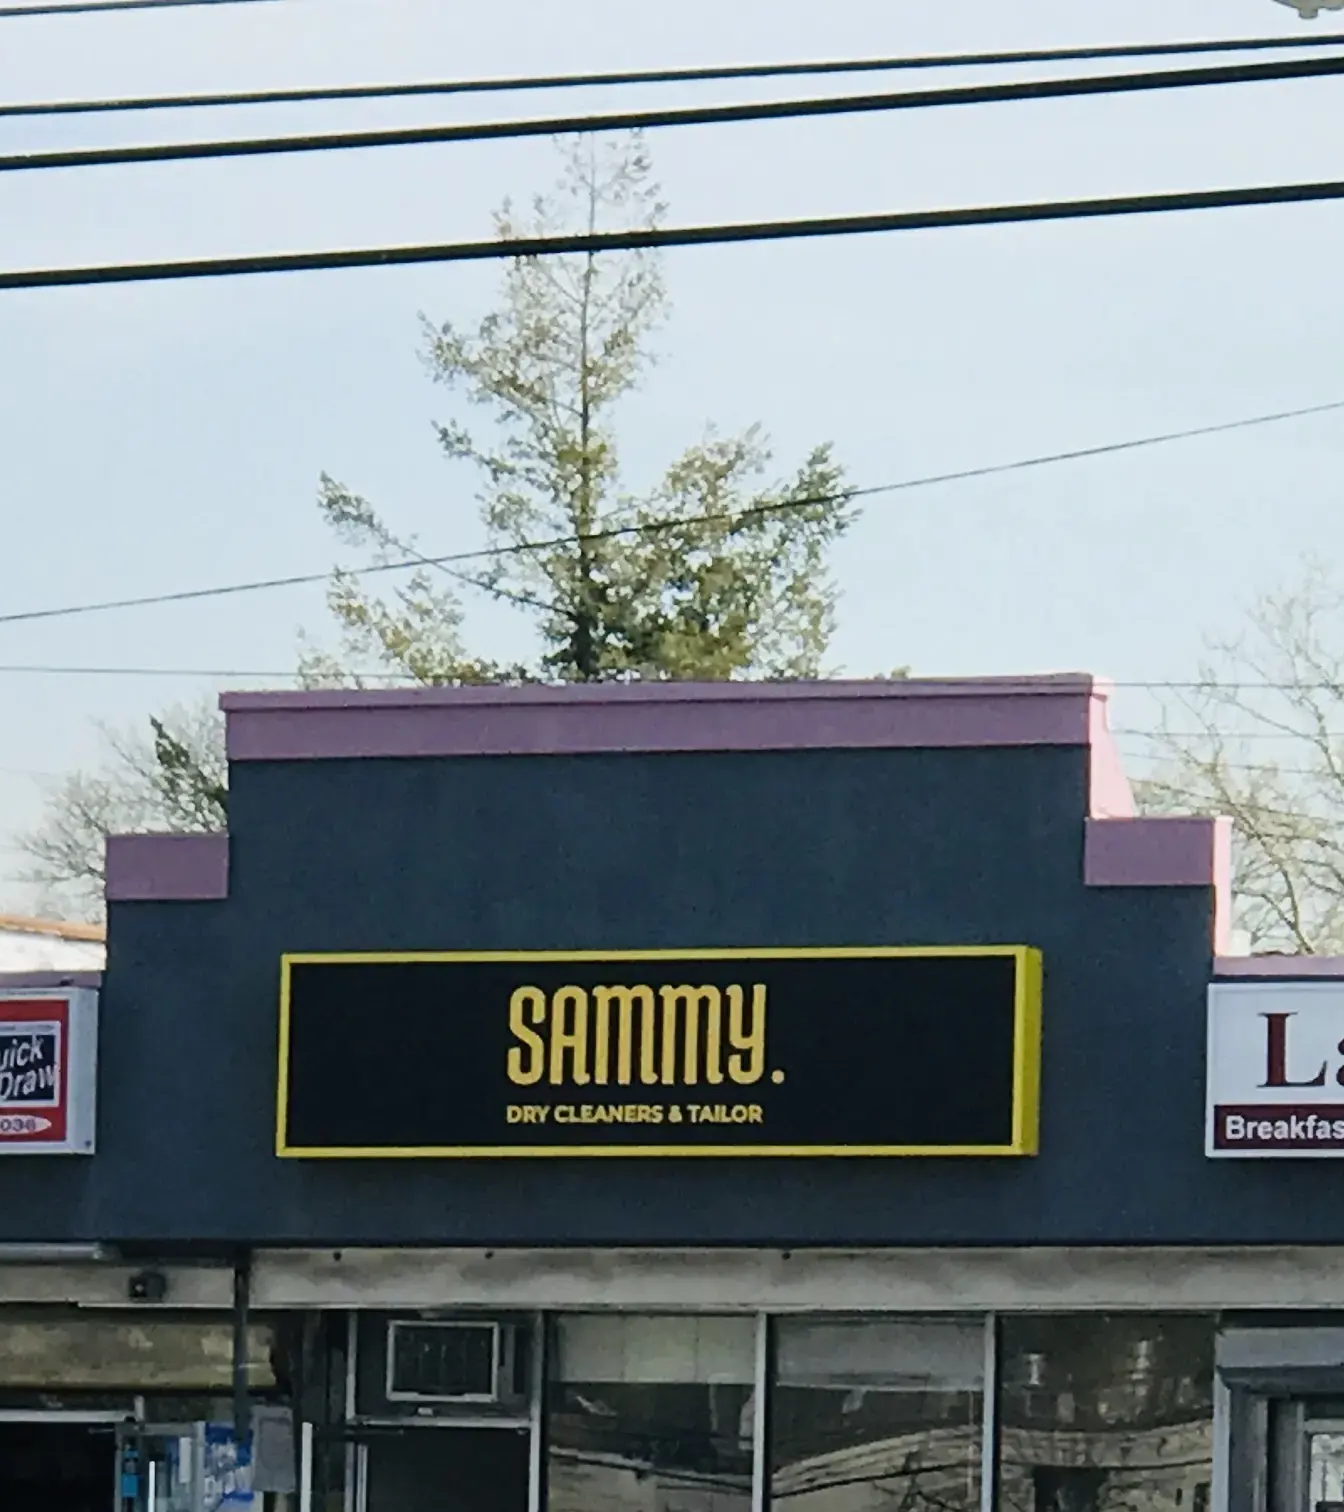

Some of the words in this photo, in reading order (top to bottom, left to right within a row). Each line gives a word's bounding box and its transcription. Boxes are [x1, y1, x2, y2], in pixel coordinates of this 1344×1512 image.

[506, 1104, 550, 1124] DRY
[553, 1104, 664, 1124] CLEANERS
[668, 1104, 683, 1124] &
[686, 1103, 764, 1124] TAILOR
